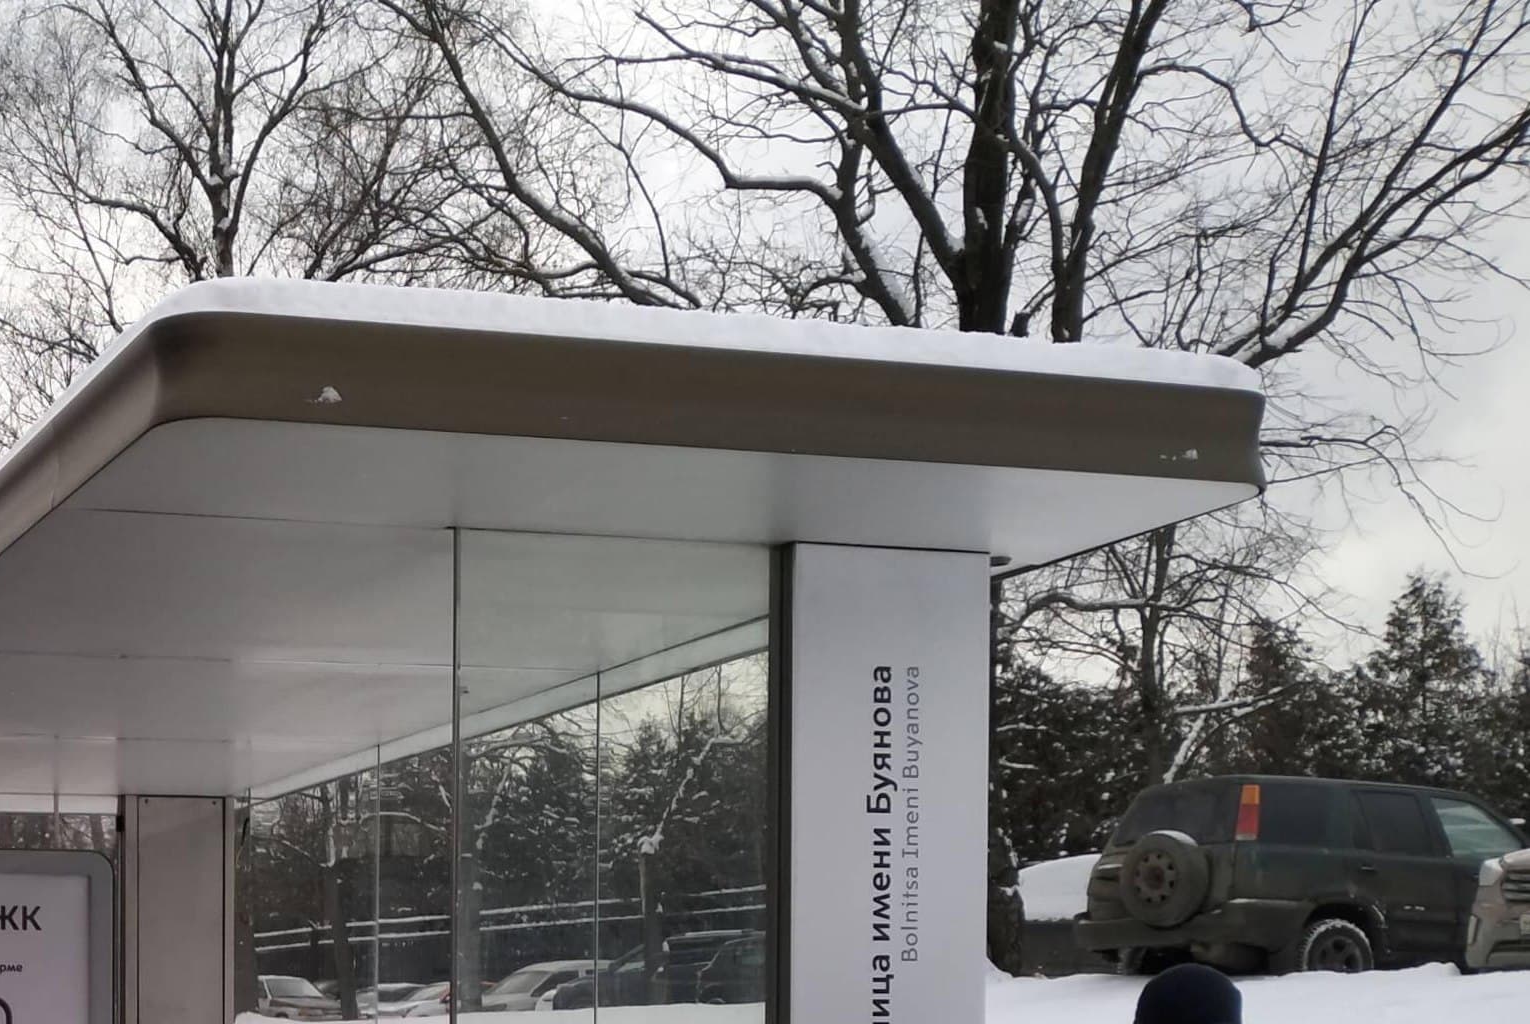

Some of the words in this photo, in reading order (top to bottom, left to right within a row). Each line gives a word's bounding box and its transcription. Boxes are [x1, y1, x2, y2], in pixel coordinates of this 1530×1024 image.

[866, 664, 898, 814] Буянова
[902, 665, 923, 779] Buyanova
[902, 787, 919, 859] Imeni
[872, 827, 891, 941] имени
[901, 866, 919, 962] Bolnitsa
